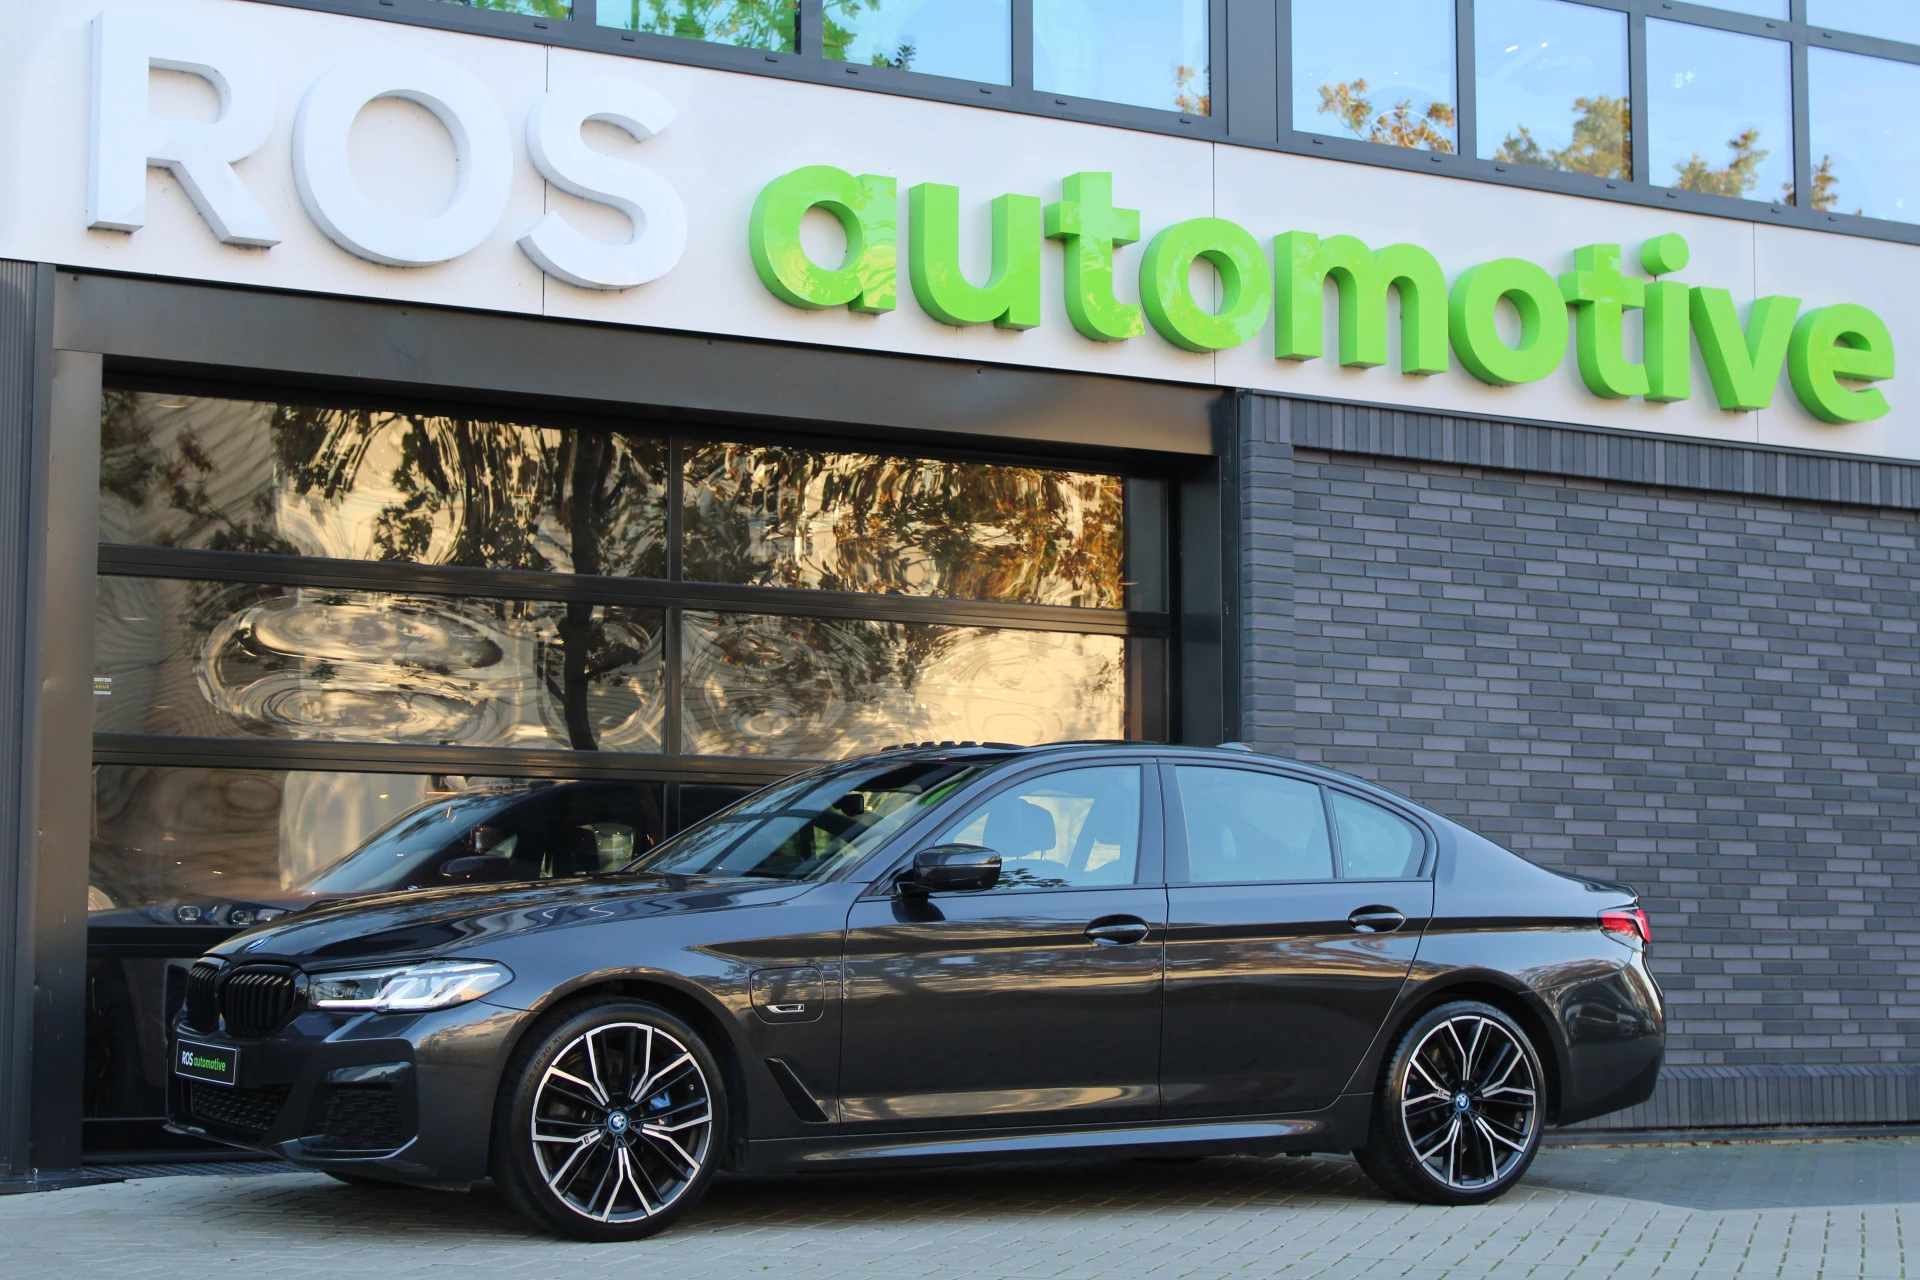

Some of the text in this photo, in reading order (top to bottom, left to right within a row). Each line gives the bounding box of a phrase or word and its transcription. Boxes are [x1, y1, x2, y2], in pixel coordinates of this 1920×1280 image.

[86, 11, 1896, 424] ROS automotive
[182, 1051, 226, 1072] ROS automotive
